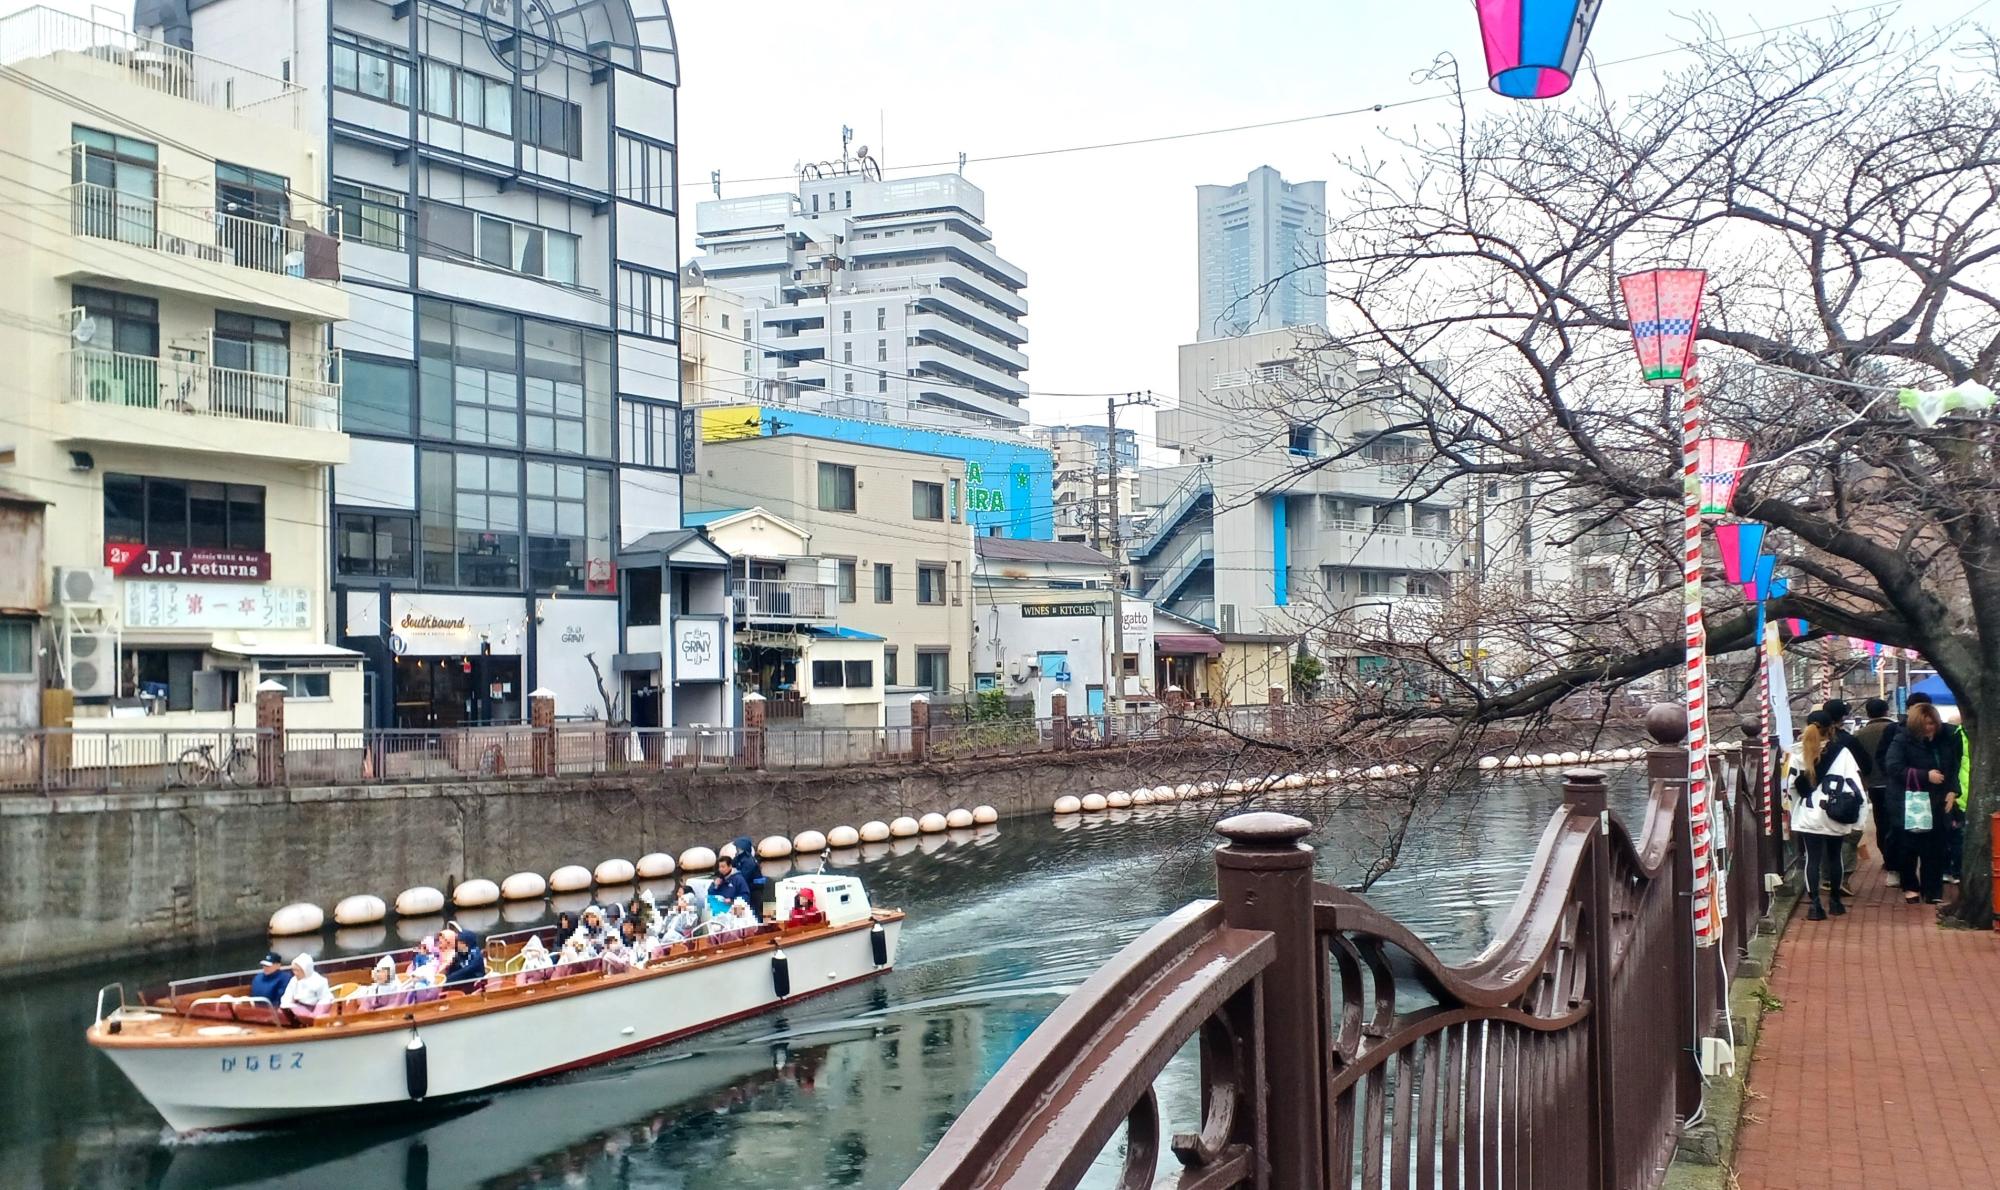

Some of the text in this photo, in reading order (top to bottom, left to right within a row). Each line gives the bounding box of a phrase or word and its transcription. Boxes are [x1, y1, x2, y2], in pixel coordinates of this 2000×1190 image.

[110, 547, 130, 563] 2F
[141, 549, 259, 577] J.J. returns
[1023, 606, 1050, 616] WINES
[1059, 605, 1096, 616] KITCHEN
[401, 613, 465, 629] Southbound
